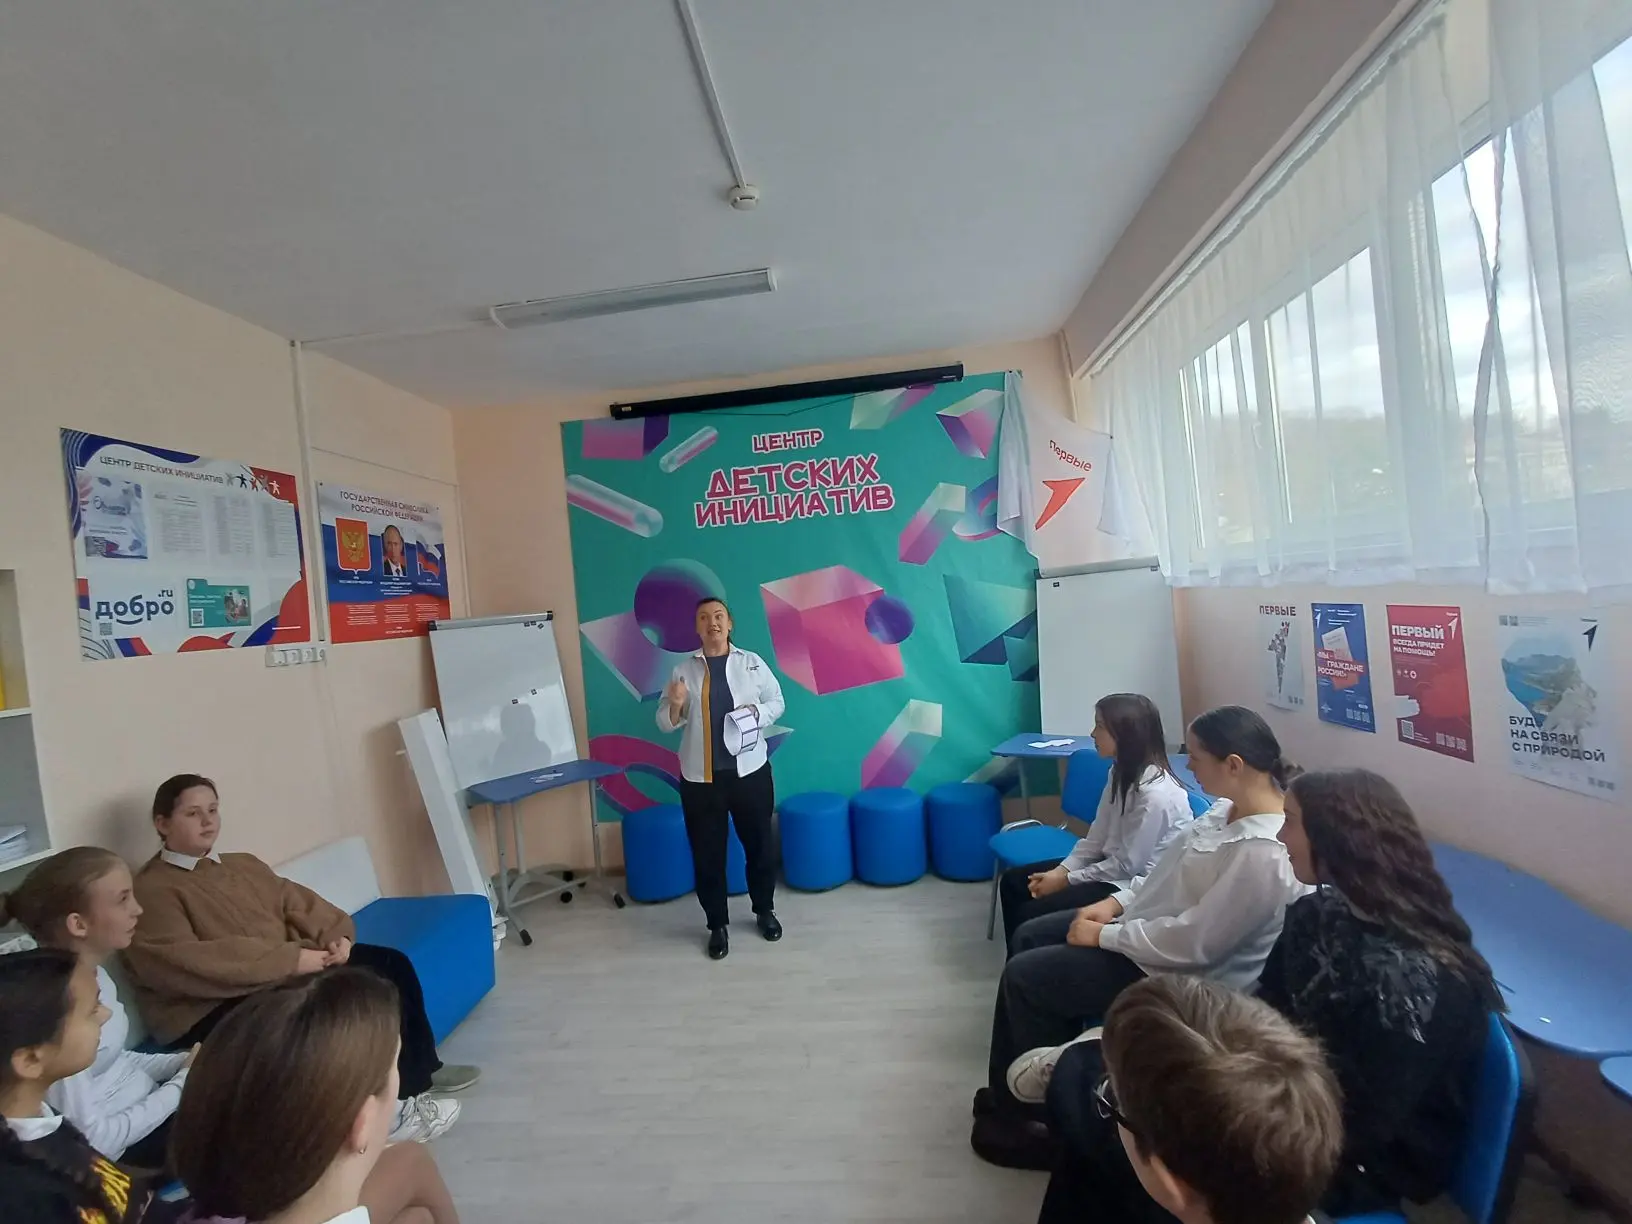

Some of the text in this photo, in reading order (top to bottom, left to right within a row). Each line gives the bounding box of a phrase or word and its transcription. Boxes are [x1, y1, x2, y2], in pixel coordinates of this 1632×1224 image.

[752, 428, 824, 453] ЦЕНТР
[100, 456, 224, 484] ЦЕНТР ДЕТСКИХ ИНИЦИАТИВ
[705, 453, 880, 499] ДЕТСКИХ
[694, 483, 895, 528] ИНИЦИАТИВ
[95, 594, 174, 621] добро
[1259, 605, 1297, 617] ПЕРВЫЕ
[1391, 624, 1445, 640] ПЕРВЫЙ
[1326, 660, 1364, 673] ГРАЖДАНЕ
[1510, 729, 1579, 744] НА СВЯЗИ
[1512, 742, 1605, 762] С ПРИРОДОЙ
